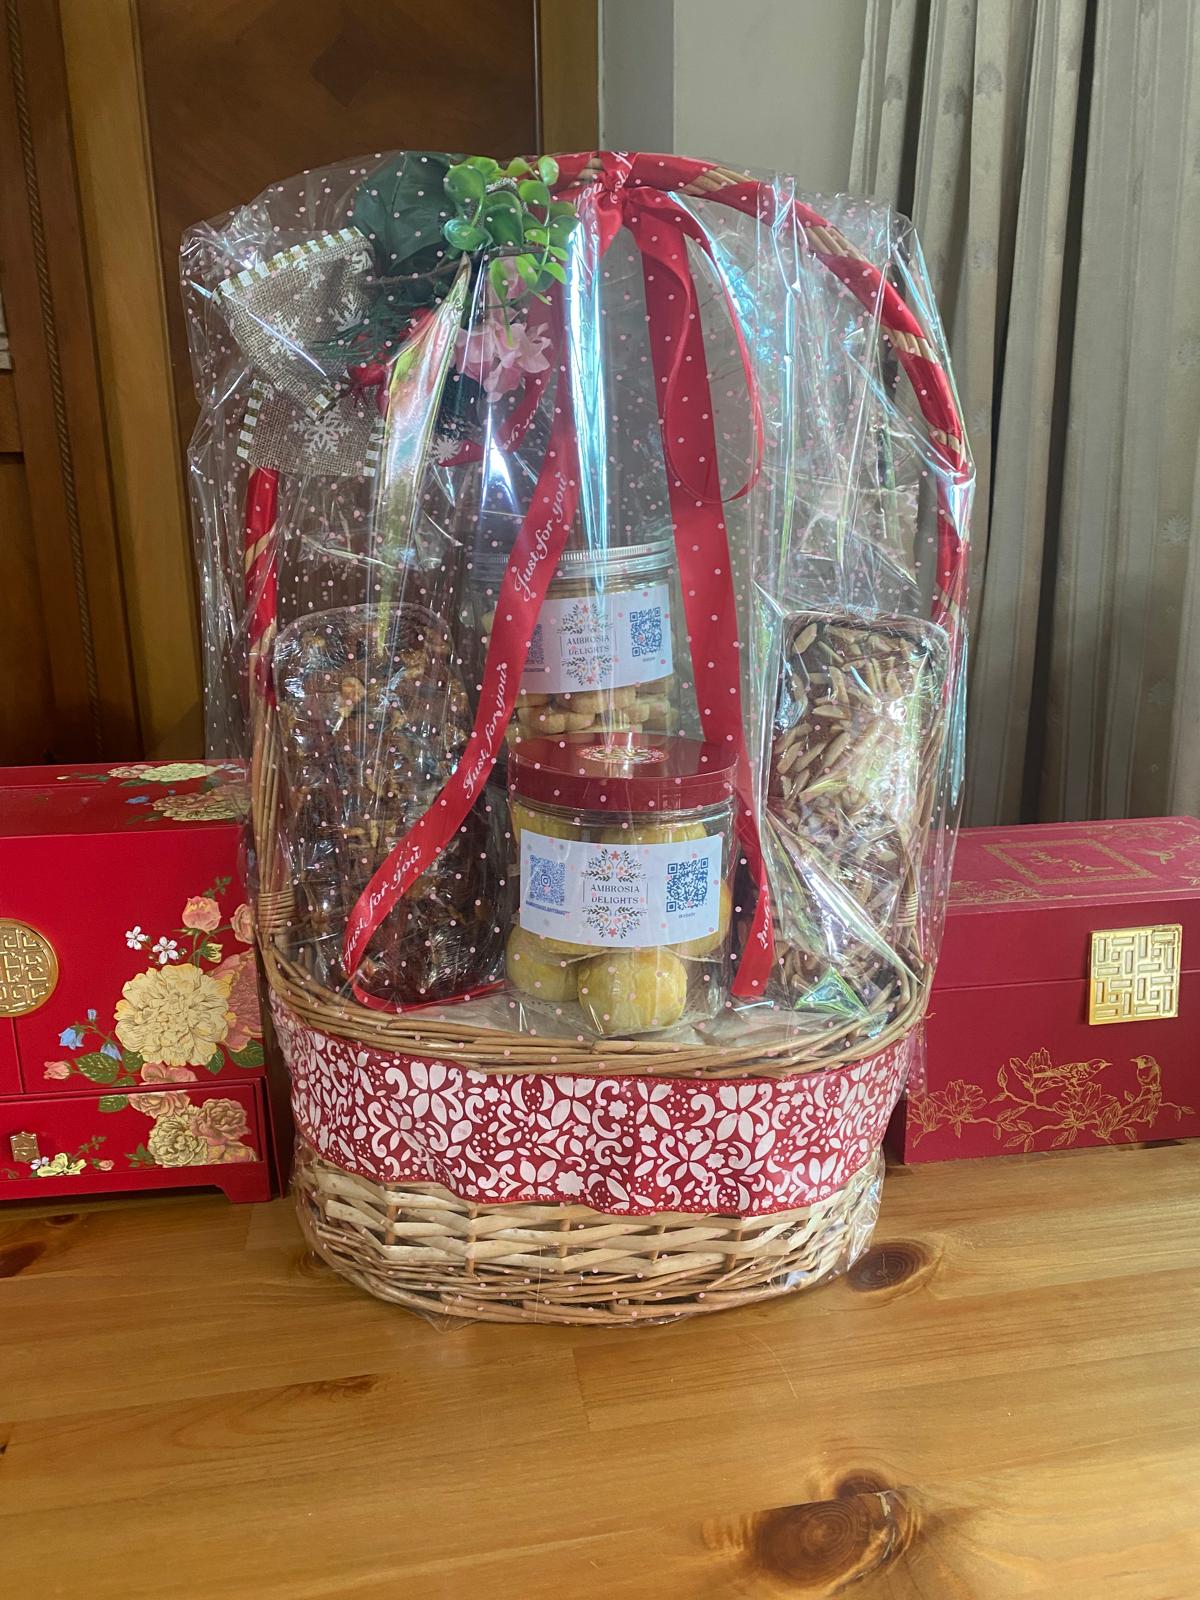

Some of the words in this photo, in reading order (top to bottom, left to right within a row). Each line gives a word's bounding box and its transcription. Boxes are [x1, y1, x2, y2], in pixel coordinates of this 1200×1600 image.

[514, 551, 540, 602] Just
[535, 519, 553, 560] for
[552, 474, 568, 524] you
[566, 634, 610, 646] AMBROSIA
[568, 645, 610, 656] DELIGHTS
[463, 749, 490, 800] Just
[485, 711, 500, 754] for
[495, 667, 508, 716] you
[368, 881, 389, 926] for
[390, 848, 422, 890] you
[590, 883, 641, 894] AMBROSIA
[591, 896, 640, 905] DELIGHTS
